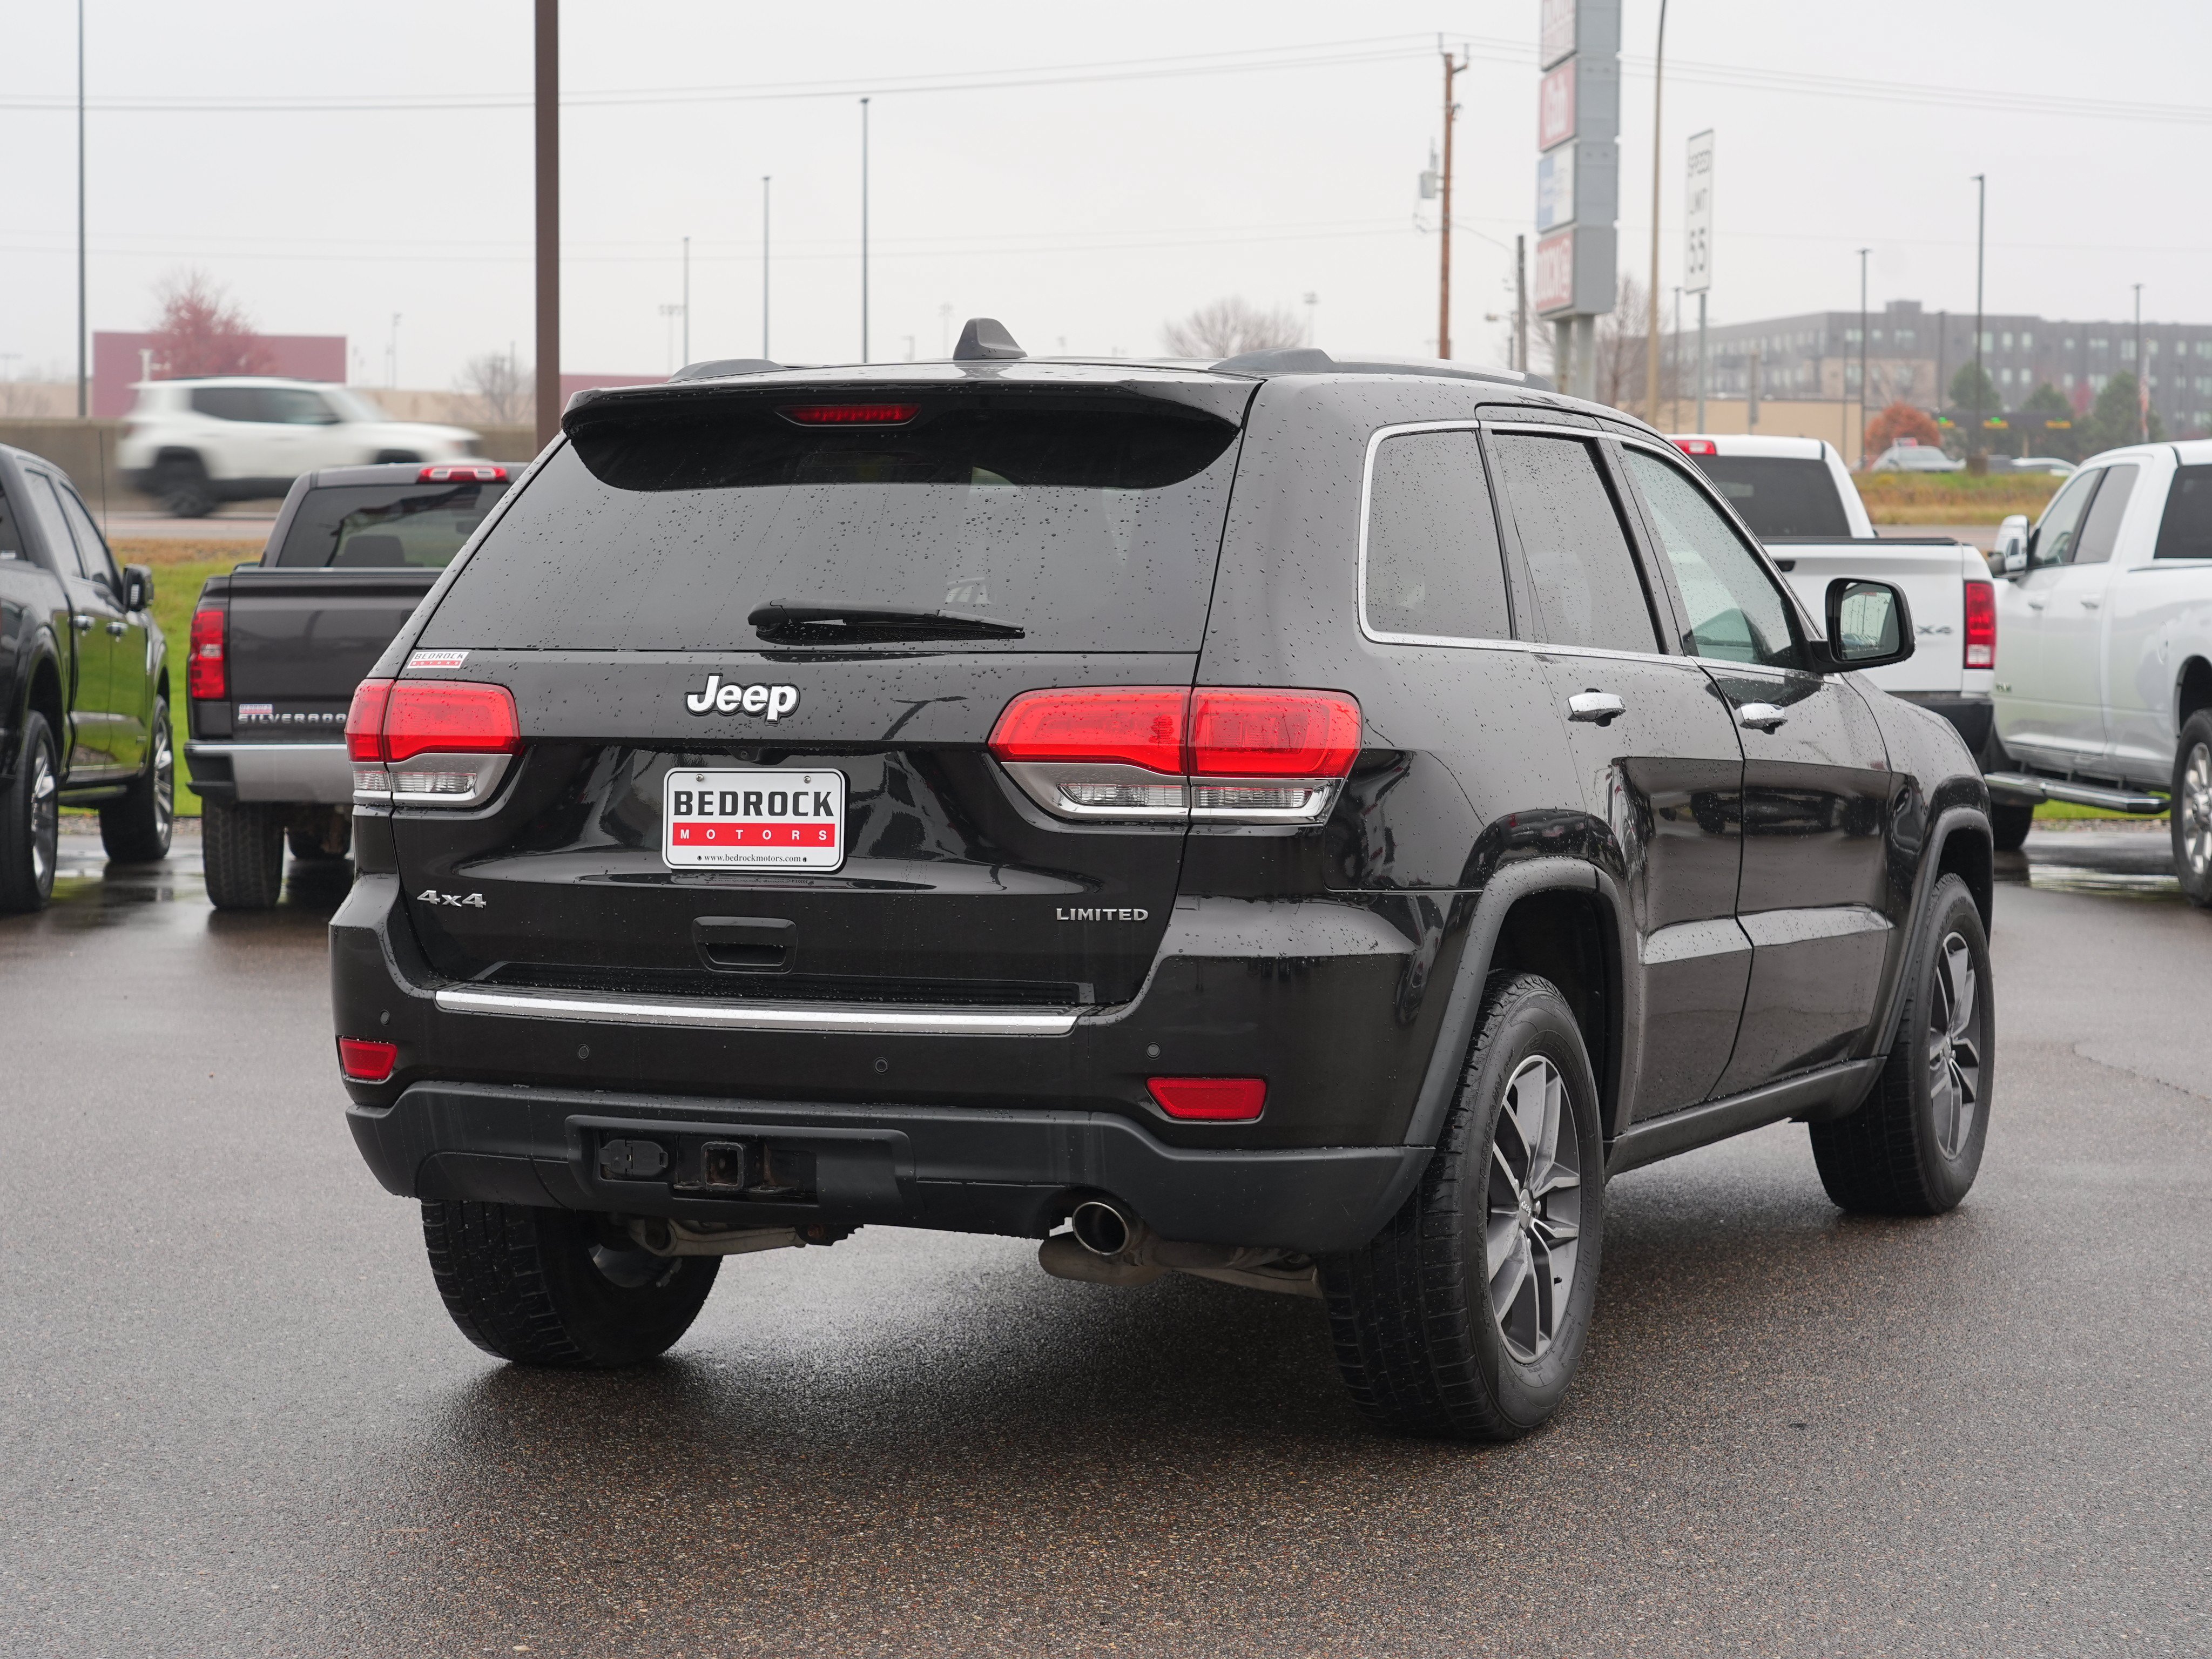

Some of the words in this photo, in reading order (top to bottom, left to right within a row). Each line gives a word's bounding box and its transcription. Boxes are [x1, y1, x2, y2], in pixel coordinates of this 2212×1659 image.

[686, 675, 799, 723] Jeep
[238, 713, 347, 724] SILVERADO
[673, 790, 834, 817] BEDROCK
[680, 829, 827, 840] MOTORS
[704, 853, 801, 863] www.bedrockmotors.com
[417, 889, 487, 908] 4x4
[1056, 908, 1149, 921] LIMITED
